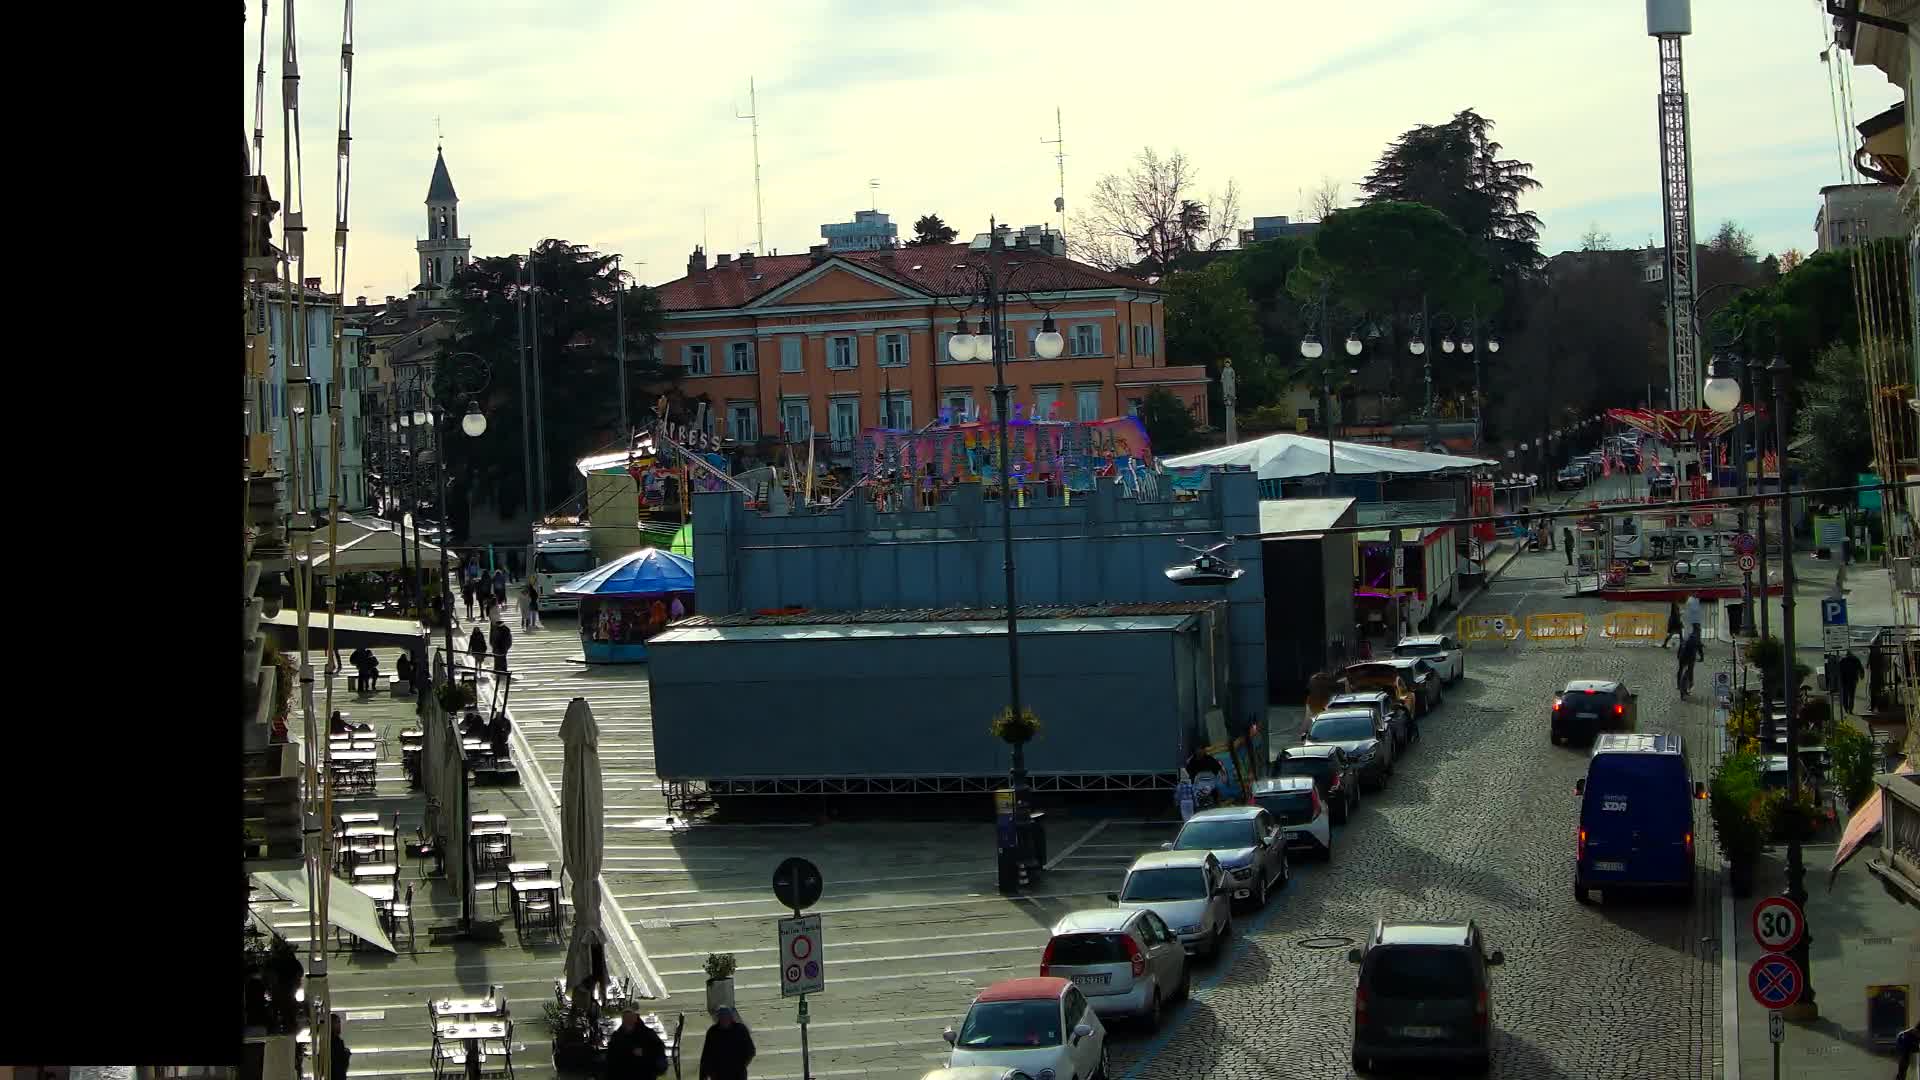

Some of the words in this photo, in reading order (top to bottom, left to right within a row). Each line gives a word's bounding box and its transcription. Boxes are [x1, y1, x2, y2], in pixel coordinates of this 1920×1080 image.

[1742, 558, 1751, 567] 20
[1826, 602, 1841, 622] P
[1602, 801, 1627, 811] SDA
[1762, 911, 1791, 938] 30
